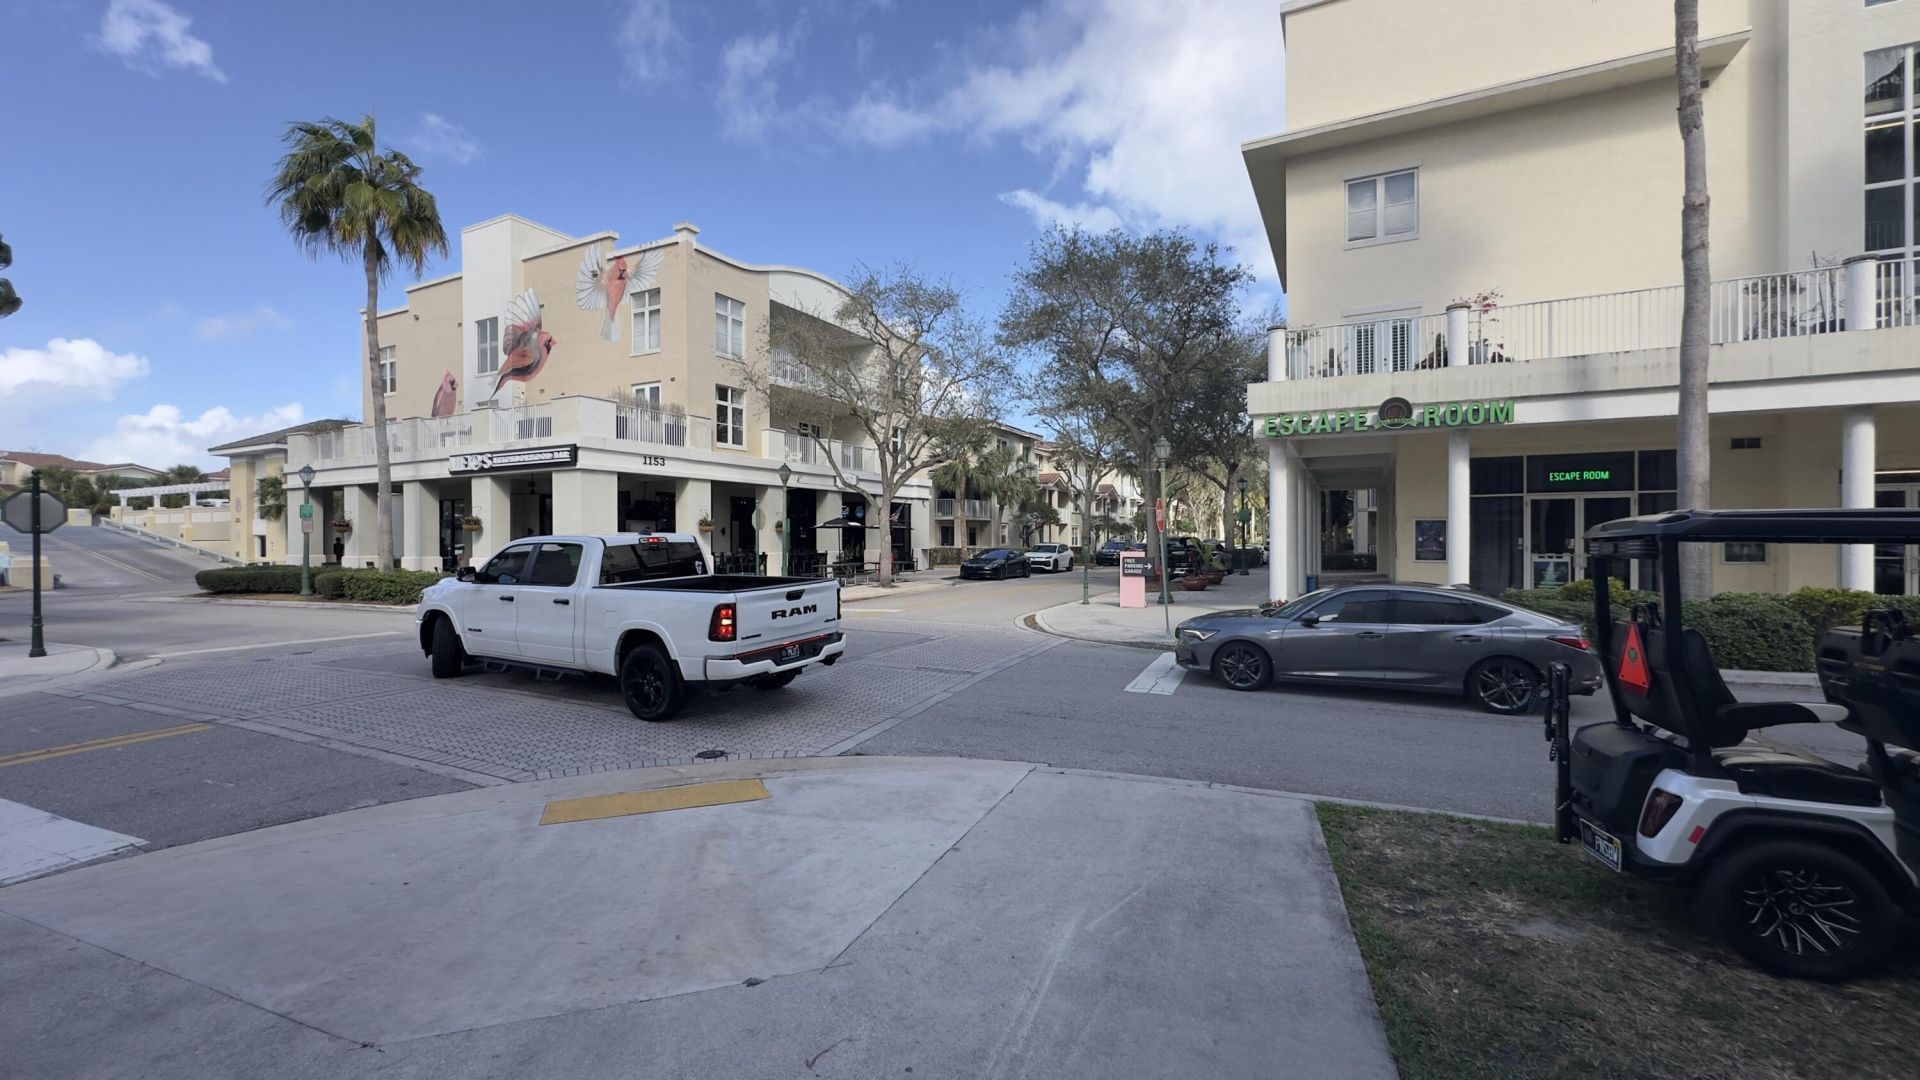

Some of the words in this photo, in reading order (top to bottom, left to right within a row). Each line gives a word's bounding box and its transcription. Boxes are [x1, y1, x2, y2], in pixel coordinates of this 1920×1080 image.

[1263, 409, 1369, 437] ESCAPE
[1422, 400, 1515, 427] ROOM
[642, 456, 666, 467] 1153
[1549, 471, 1581, 481] ESCAPE
[1583, 470, 1609, 480] ROOM
[771, 604, 817, 620] RAM
